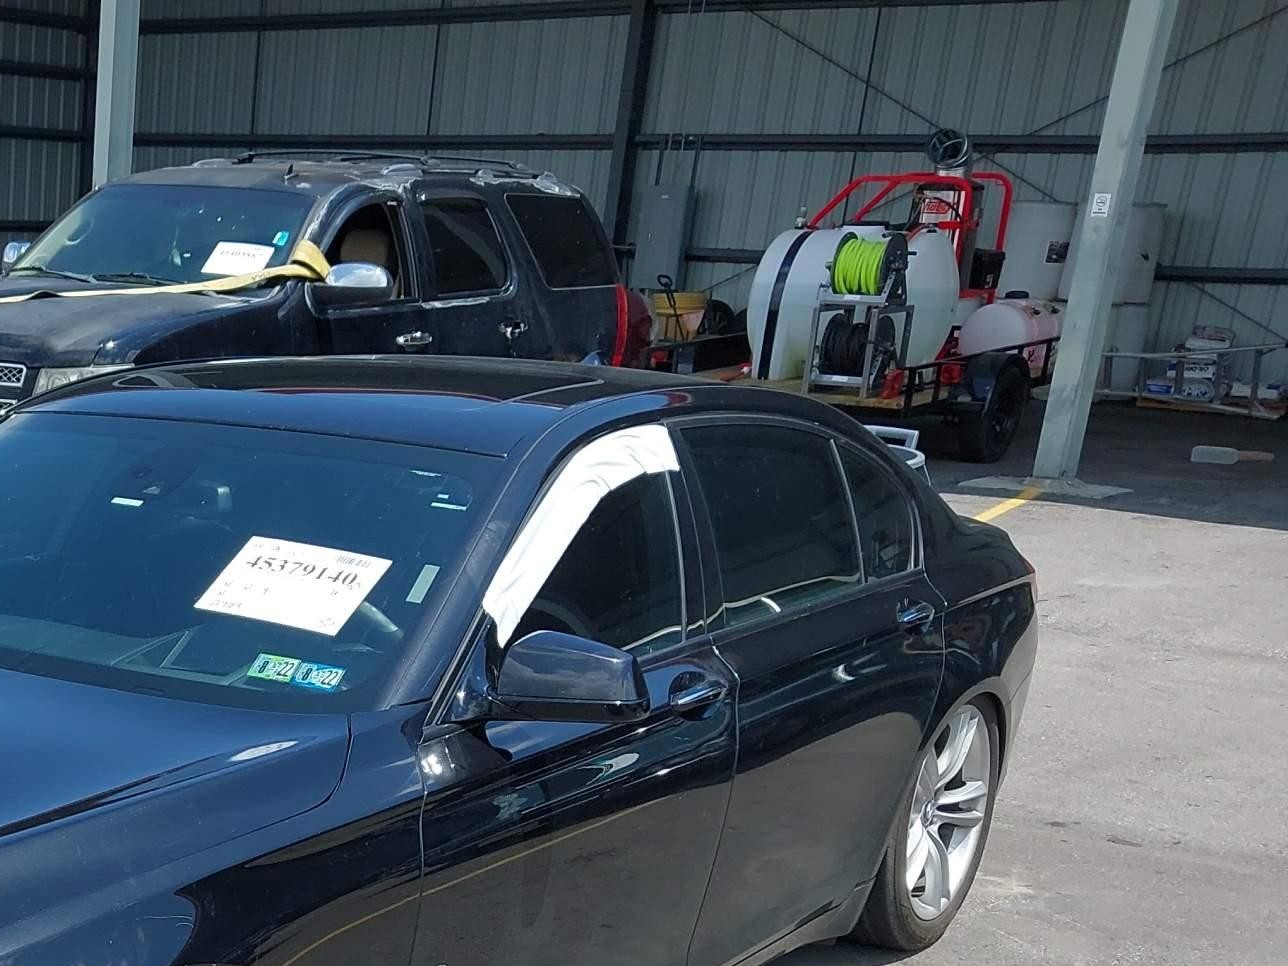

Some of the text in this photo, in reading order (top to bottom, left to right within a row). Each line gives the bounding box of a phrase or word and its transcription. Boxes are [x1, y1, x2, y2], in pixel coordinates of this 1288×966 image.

[246, 555, 359, 586] 45379140
[276, 661, 295, 678] 22
[320, 670, 339, 686] 22
